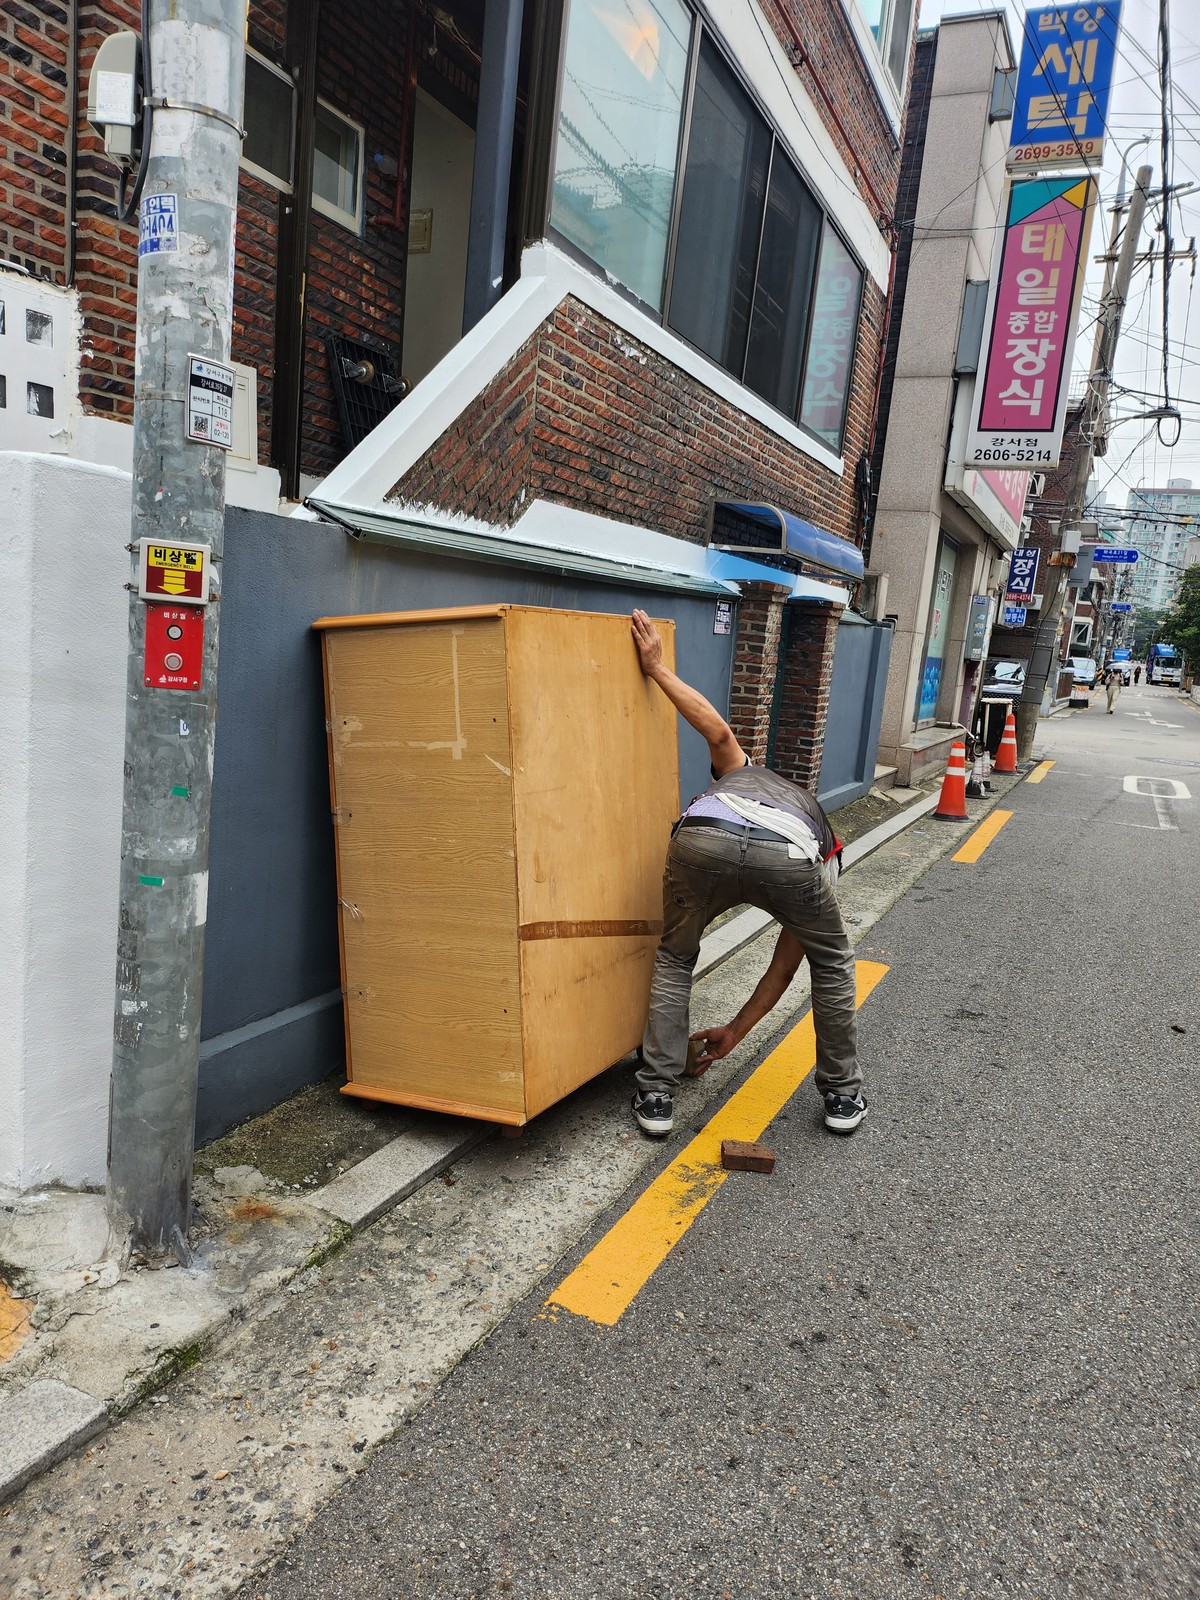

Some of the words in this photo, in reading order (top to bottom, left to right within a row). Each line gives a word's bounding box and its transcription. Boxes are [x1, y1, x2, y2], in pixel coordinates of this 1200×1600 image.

[1038, 7, 1105, 35] 백양
[1027, 38, 1098, 135] 세탁
[1015, 142, 1094, 161] 2699-3529
[1016, 224, 1066, 305] 태일
[1008, 310, 1058, 334] 종합
[998, 339, 1056, 416] 장식
[218, 407, 228, 418] 118
[214, 428, 229, 439] 02-120
[991, 438, 1038, 447] 강서점
[974, 449, 1051, 461] 2606-5214
[154, 549, 196, 565] 비상벨
[1010, 559, 1034, 592] 장식
[163, 611, 187, 620] 비상벨
[1004, 613, 1024, 623] 부동산
